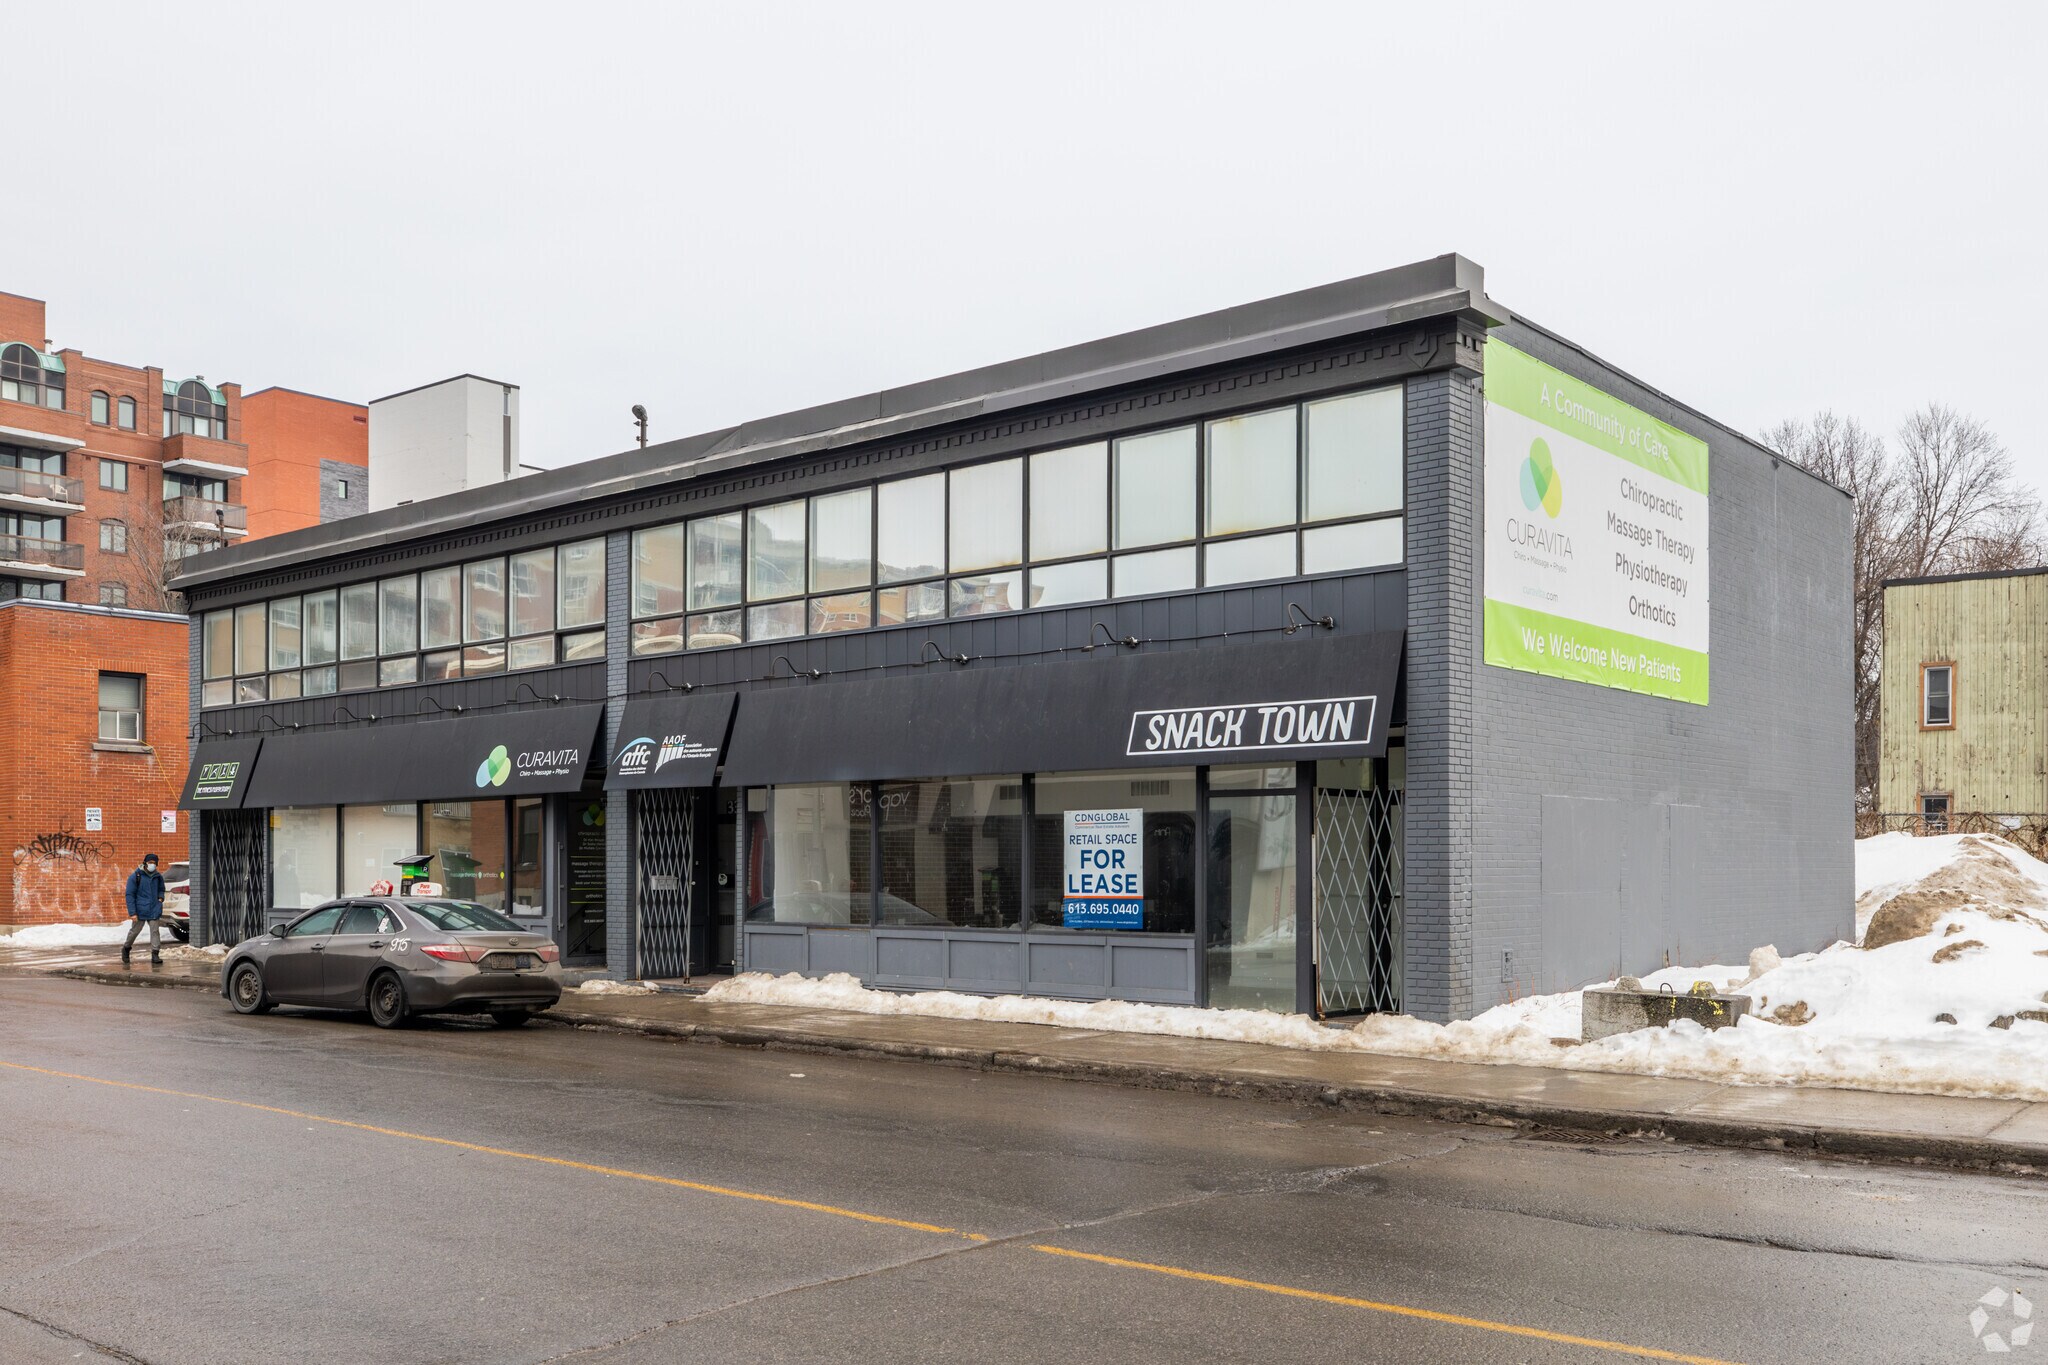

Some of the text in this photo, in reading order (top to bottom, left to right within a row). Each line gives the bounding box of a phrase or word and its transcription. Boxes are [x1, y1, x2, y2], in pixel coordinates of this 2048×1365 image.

[1540, 382, 1669, 462] A Community of Care
[1620, 478, 1683, 521] Chiropractic
[1506, 518, 1574, 560] CURAVITA
[1607, 510, 1695, 564] Massage Therapy
[1513, 550, 1568, 573] Chiro Massage Physio
[1615, 552, 1688, 598] Physiotherapy
[1522, 586, 1559, 602] curavita.com
[1629, 595, 1676, 627] Orthotics
[1521, 626, 1681, 683] We Welcome New Patients
[1145, 701, 1355, 750] SNACK TOWN
[662, 734, 687, 745] AAOF
[516, 749, 579, 768] CURAVITA
[727, 800, 737, 815] 3
[1074, 813, 1130, 822] CDNGLOBAL
[1069, 833, 1137, 845] RETAIL SPACE
[1080, 849, 1125, 869] FOR
[1069, 874, 1138, 894] LEASE
[1068, 903, 1139, 914] 613.695.0440
[390, 938, 410, 951] 915
